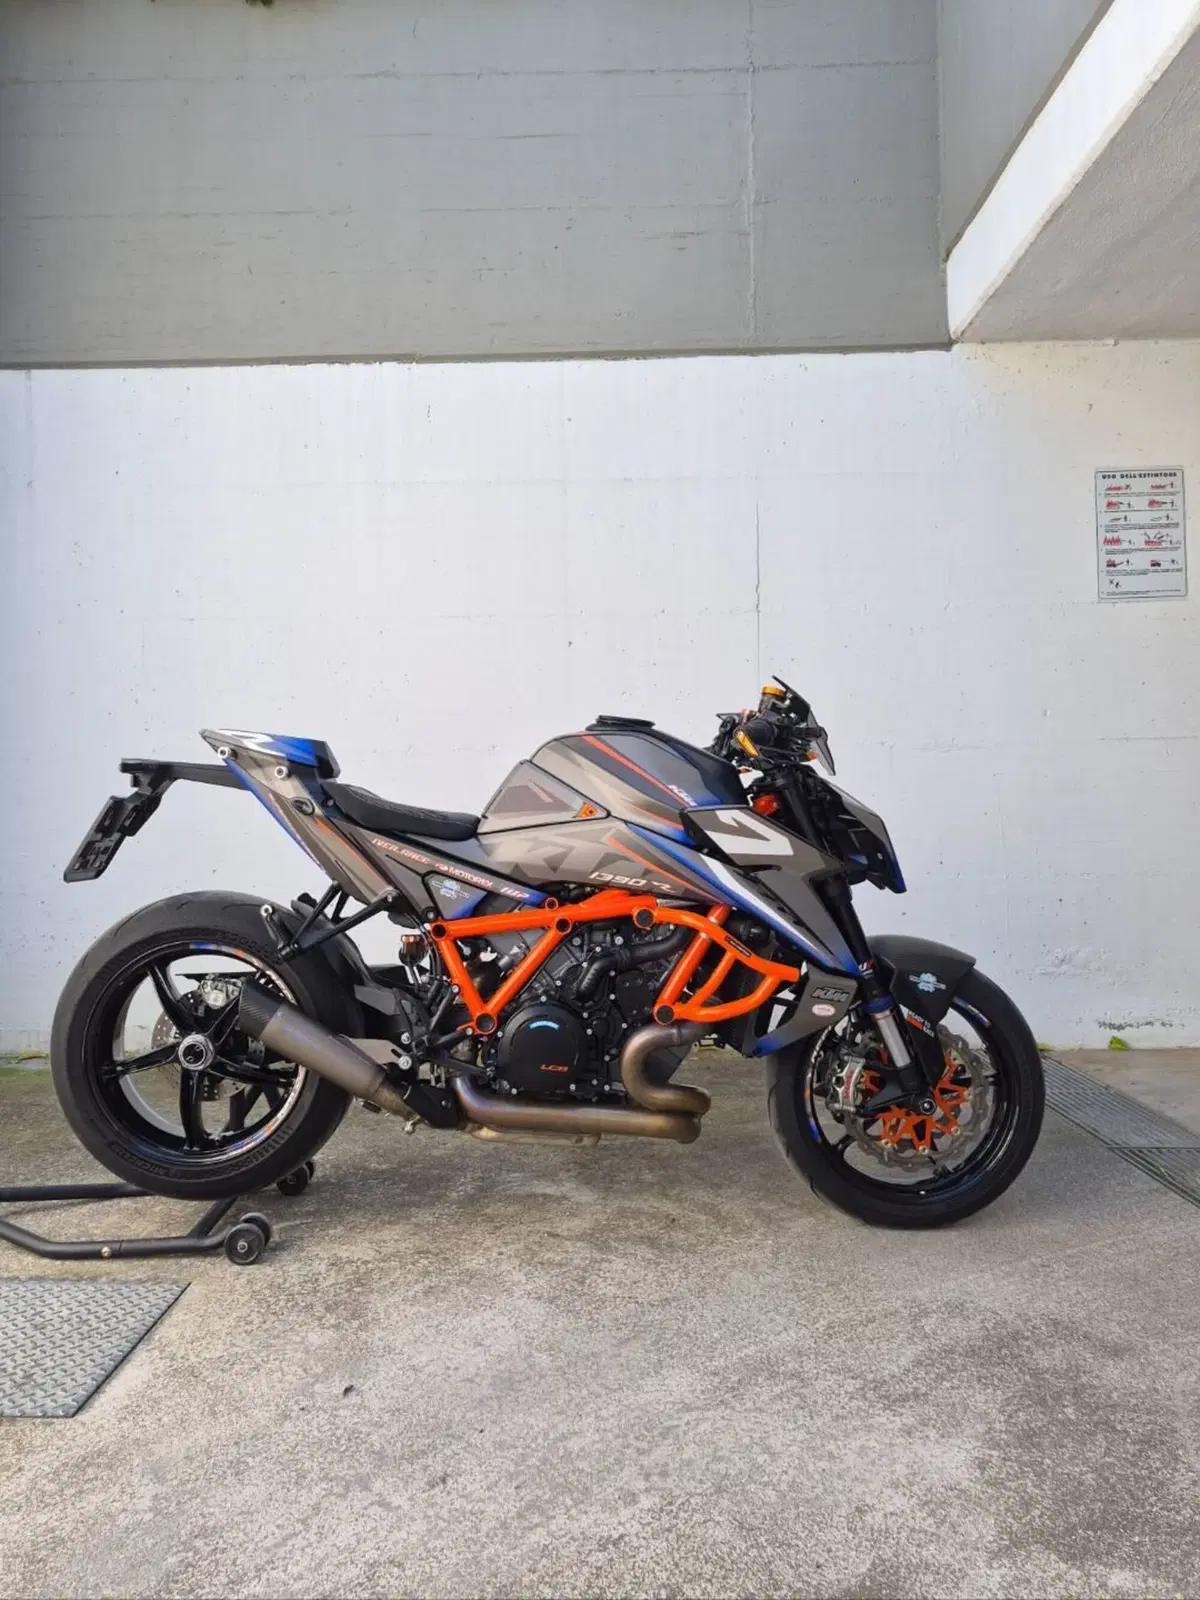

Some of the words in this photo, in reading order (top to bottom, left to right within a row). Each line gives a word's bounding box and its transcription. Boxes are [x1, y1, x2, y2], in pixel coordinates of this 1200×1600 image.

[448, 866, 494, 888] MOTOREX
[588, 871, 648, 887] 1390
[811, 985, 851, 1003] KTM
